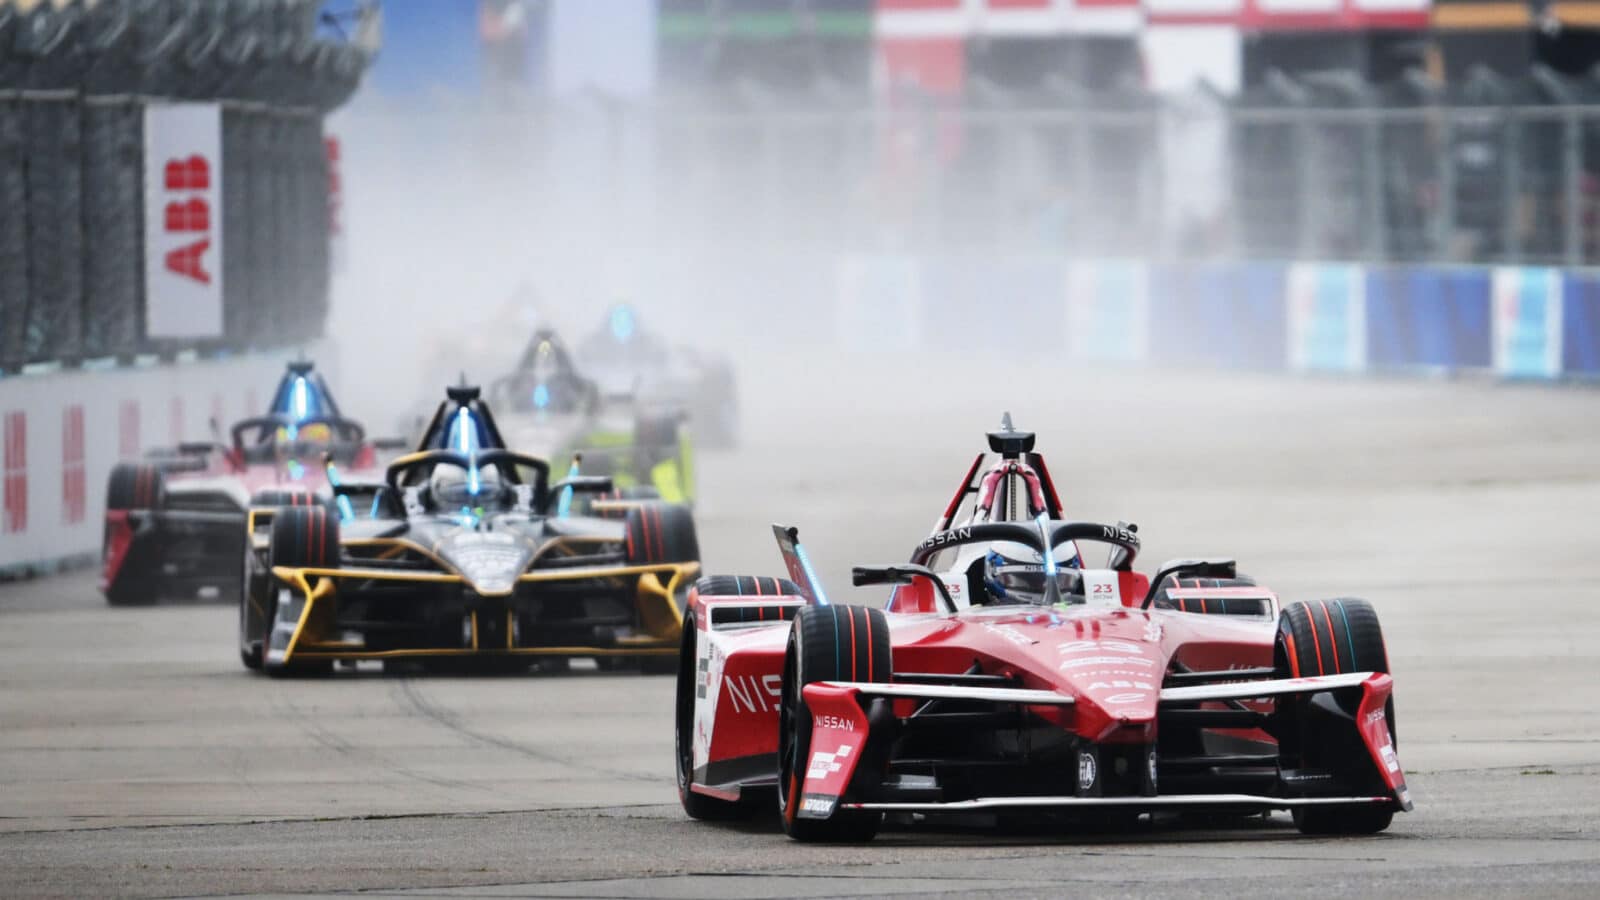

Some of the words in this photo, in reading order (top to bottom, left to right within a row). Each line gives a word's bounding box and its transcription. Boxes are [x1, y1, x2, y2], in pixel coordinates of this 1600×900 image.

[164, 153, 211, 286] ABB
[919, 528, 972, 550] NISSAN
[1093, 584, 1113, 593] 23
[1057, 640, 1144, 654] 23
[815, 715, 854, 732] NISSAN
